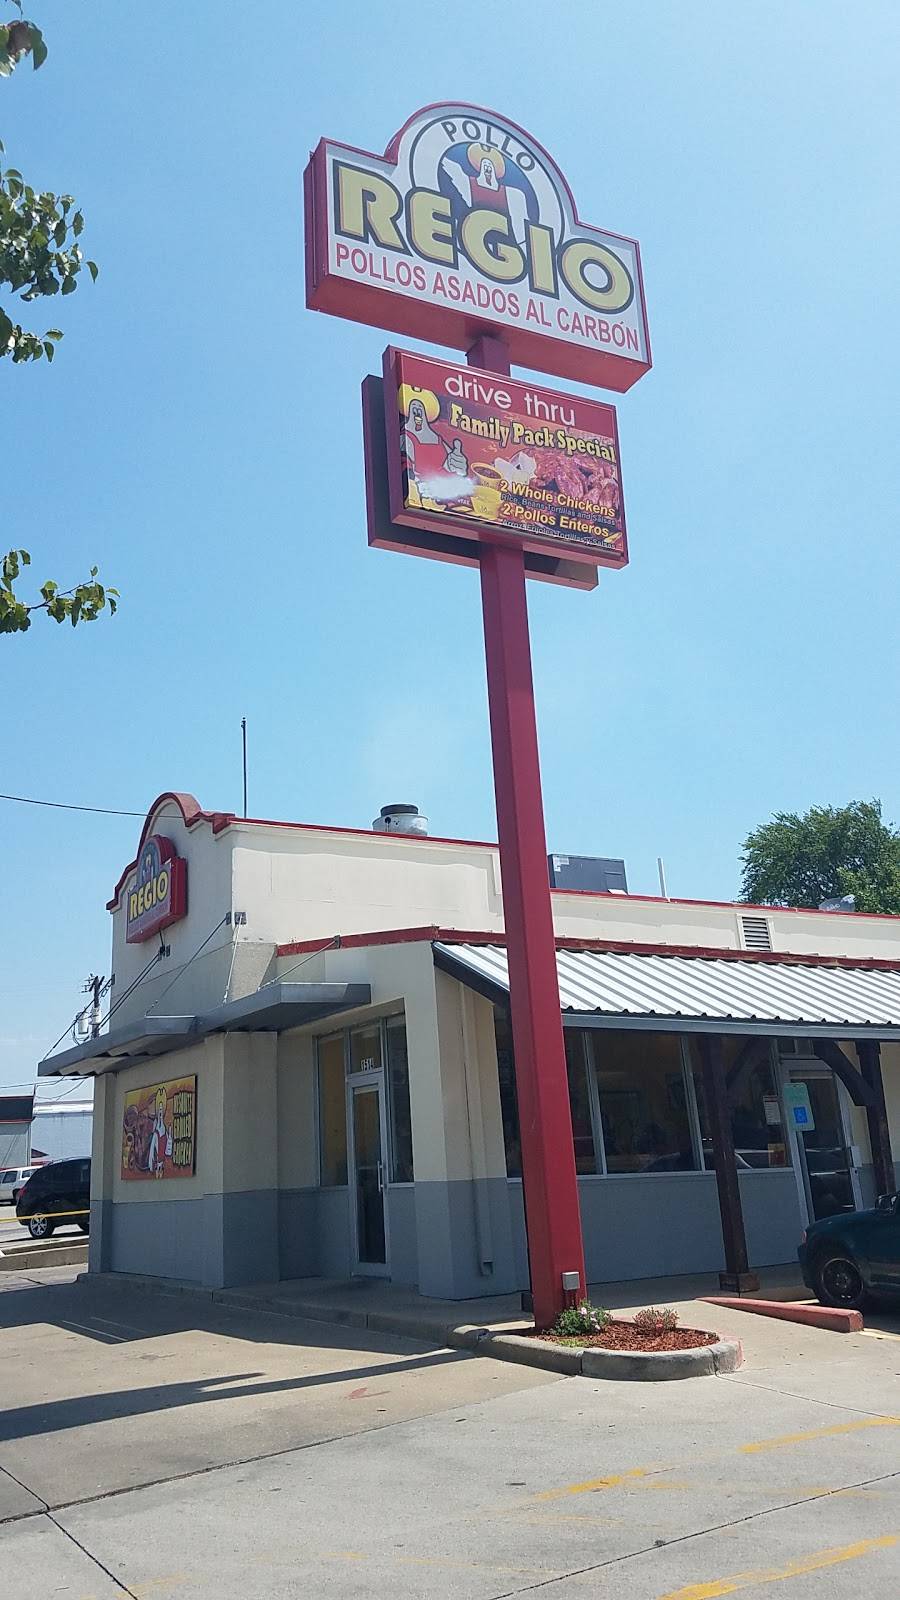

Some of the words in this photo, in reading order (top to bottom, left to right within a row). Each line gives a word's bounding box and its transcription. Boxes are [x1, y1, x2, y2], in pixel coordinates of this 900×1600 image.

[441, 120, 535, 172] POLLO
[333, 159, 634, 314] REGIO
[336, 243, 426, 291] POLLOS
[432, 272, 520, 318] ASADOS
[525, 298, 551, 327] AL
[556, 308, 639, 352] CARBÓN
[444, 375, 512, 409] drive
[523, 393, 575, 427] thru
[449, 403, 510, 447] Family
[512, 421, 555, 448] Pack
[557, 430, 616, 462] Special
[500, 480, 509, 492] 2
[512, 482, 553, 503] Whole
[557, 493, 616, 517] Chickens
[503, 503, 512, 516] 2
[515, 505, 556, 526] Pollos
[560, 515, 609, 537] Enteros
[129, 870, 168, 923] REGIO
